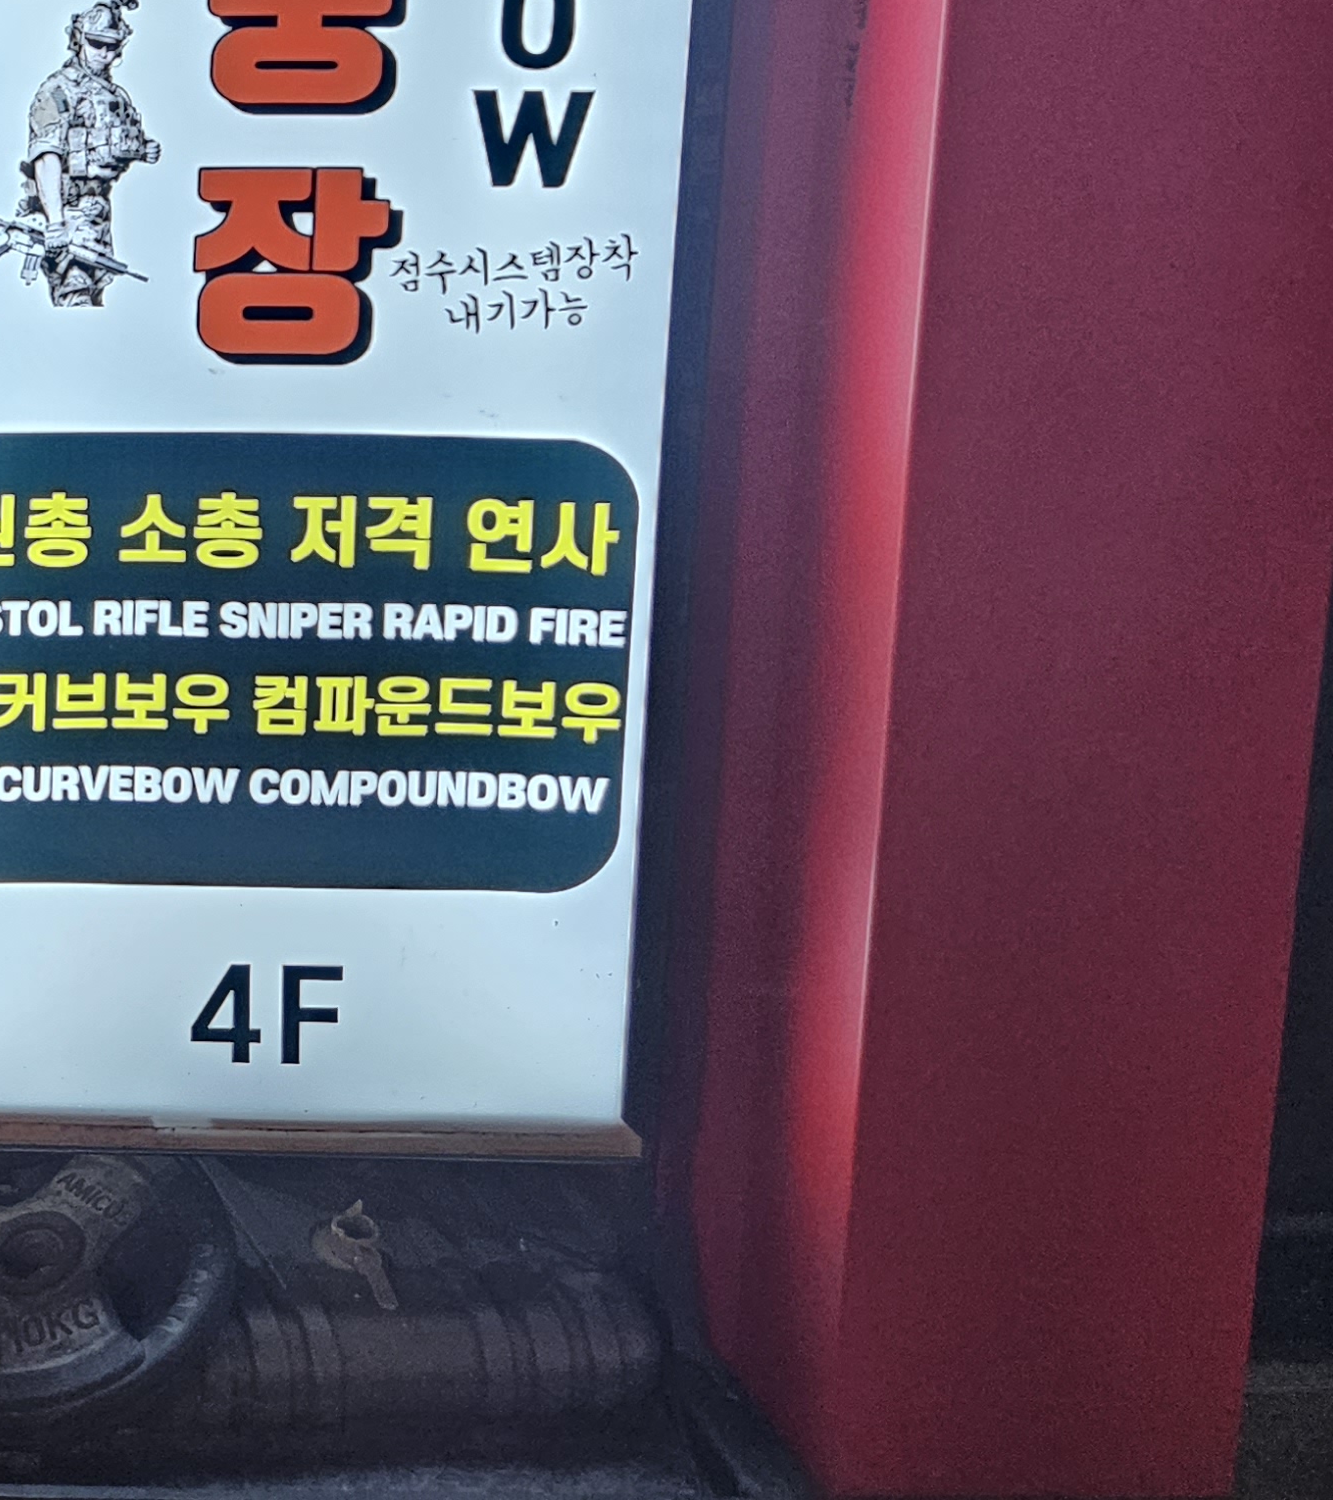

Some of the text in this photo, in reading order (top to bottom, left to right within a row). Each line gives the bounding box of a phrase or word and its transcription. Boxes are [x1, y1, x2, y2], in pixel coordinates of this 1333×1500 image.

[389, 232, 639, 296] 점수시스템장착
[444, 287, 588, 335] 내기가능
[118, 491, 264, 570] 소총
[290, 494, 434, 571] 저격
[466, 498, 620, 576] 연사
[92, 599, 210, 638] RIFLE
[218, 601, 373, 641] SNIPER
[382, 603, 518, 645] RAPID
[528, 607, 627, 648] FIRE
[252, 673, 622, 744] 컴파운드보우
[248, 768, 609, 814] COMPOUNDBOW
[189, 962, 344, 1065] 4F
[14, 1299, 101, 1353] 10KG
